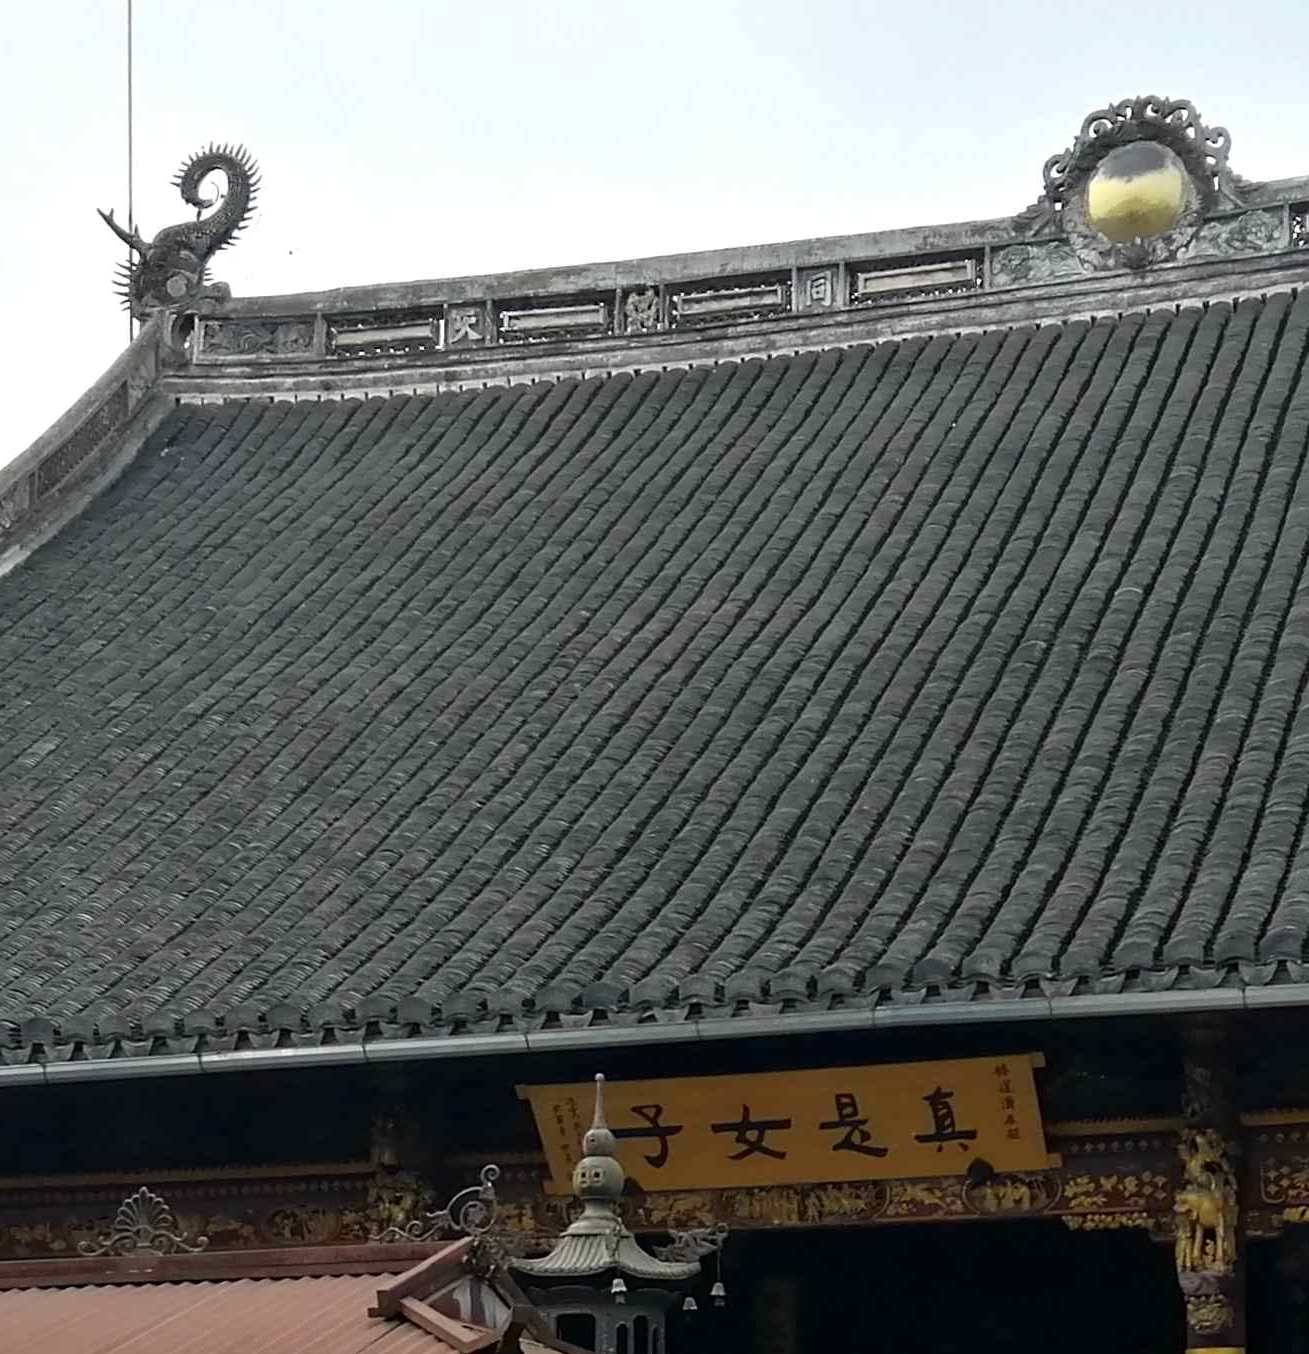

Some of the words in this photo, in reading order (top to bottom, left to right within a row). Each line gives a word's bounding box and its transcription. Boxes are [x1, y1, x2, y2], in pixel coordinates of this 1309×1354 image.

[806, 271, 832, 307] 同
[610, 1085, 978, 1167] 真是女子
